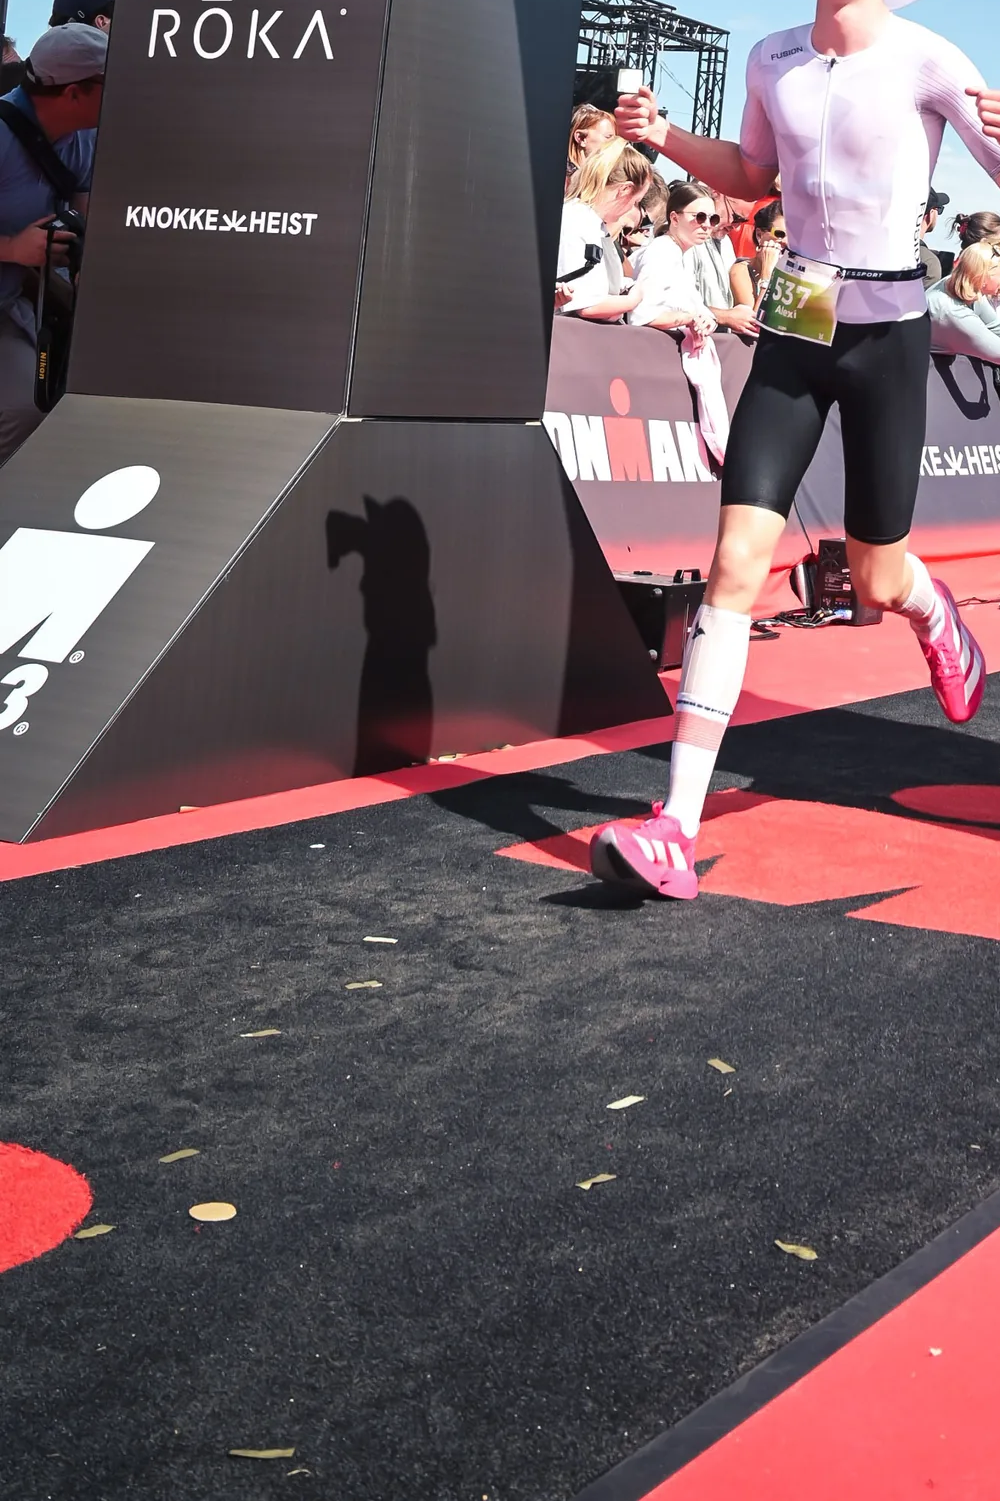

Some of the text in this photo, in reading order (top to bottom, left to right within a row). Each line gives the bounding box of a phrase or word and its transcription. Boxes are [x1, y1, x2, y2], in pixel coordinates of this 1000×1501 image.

[770, 46, 804, 61] FUSION
[125, 206, 318, 235] KNOKKE HEIST
[772, 277, 812, 309] 537
[775, 304, 797, 320] Alexi
[39, 352, 47, 379] Nikon
